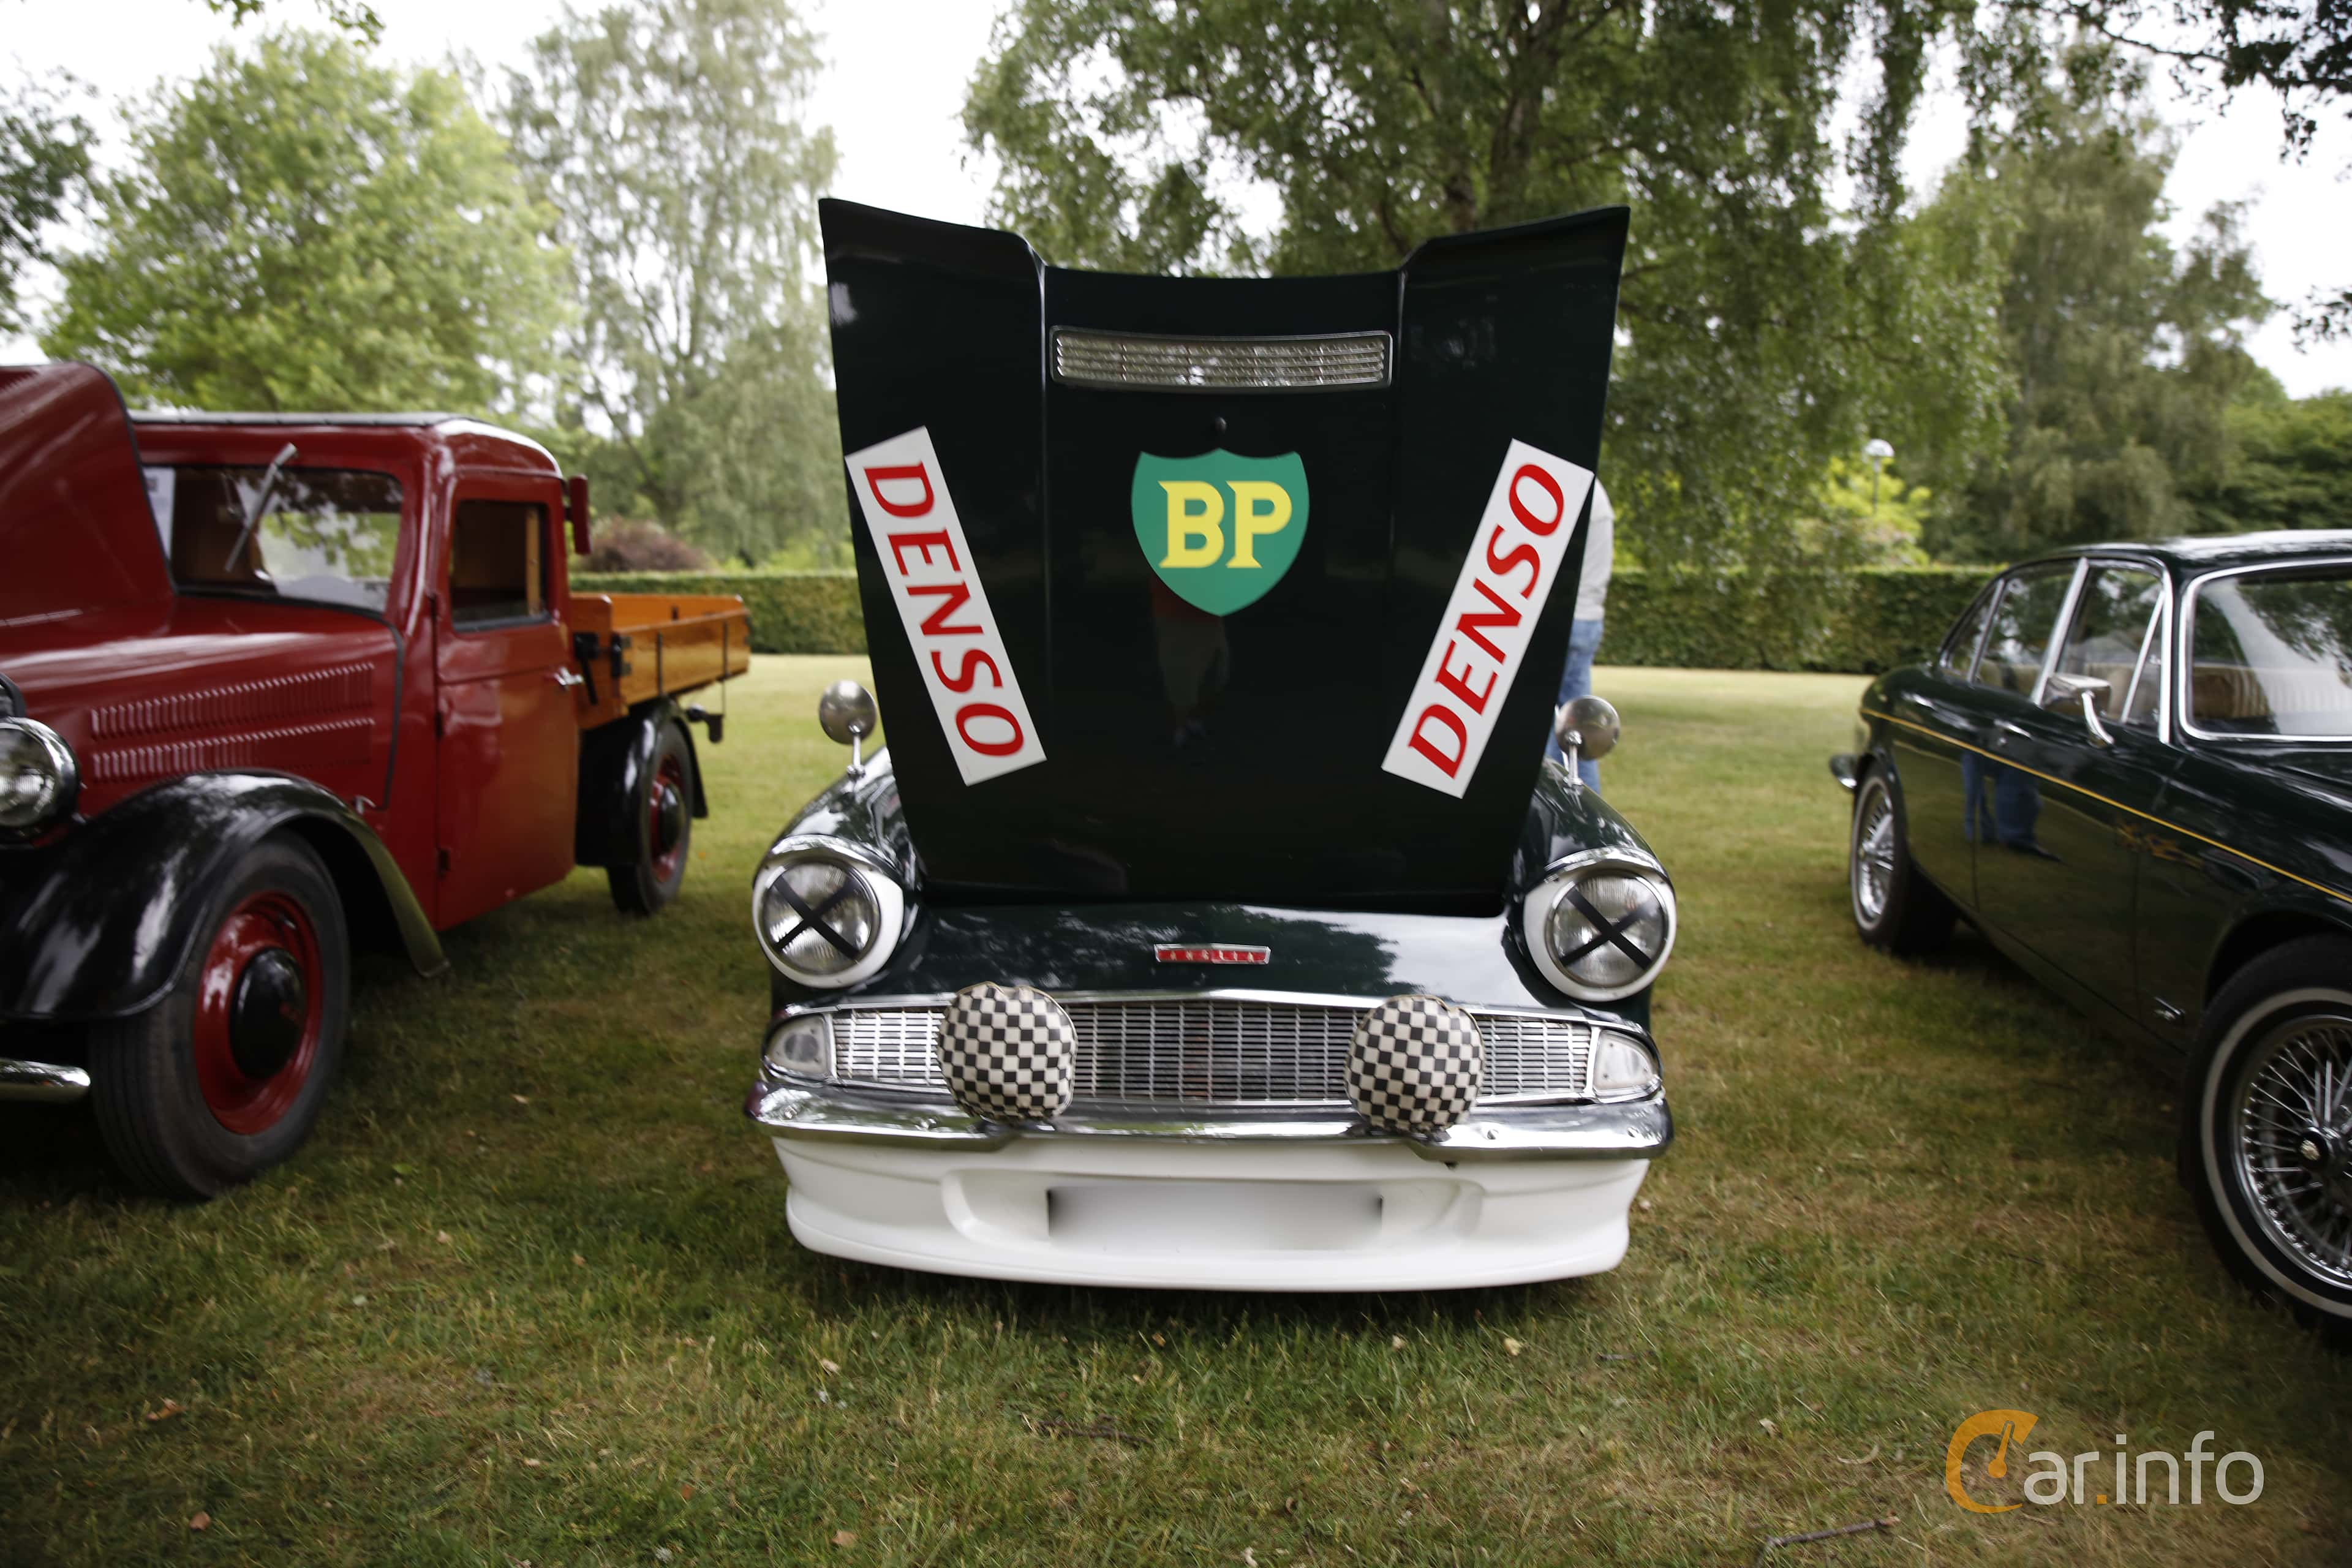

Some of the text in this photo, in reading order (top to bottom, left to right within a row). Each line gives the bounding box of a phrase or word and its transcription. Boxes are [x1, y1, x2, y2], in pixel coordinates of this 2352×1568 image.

[863, 461, 1024, 757] DENSO
[1158, 480, 1292, 568] BP
[1408, 464, 1564, 779] DENSO
